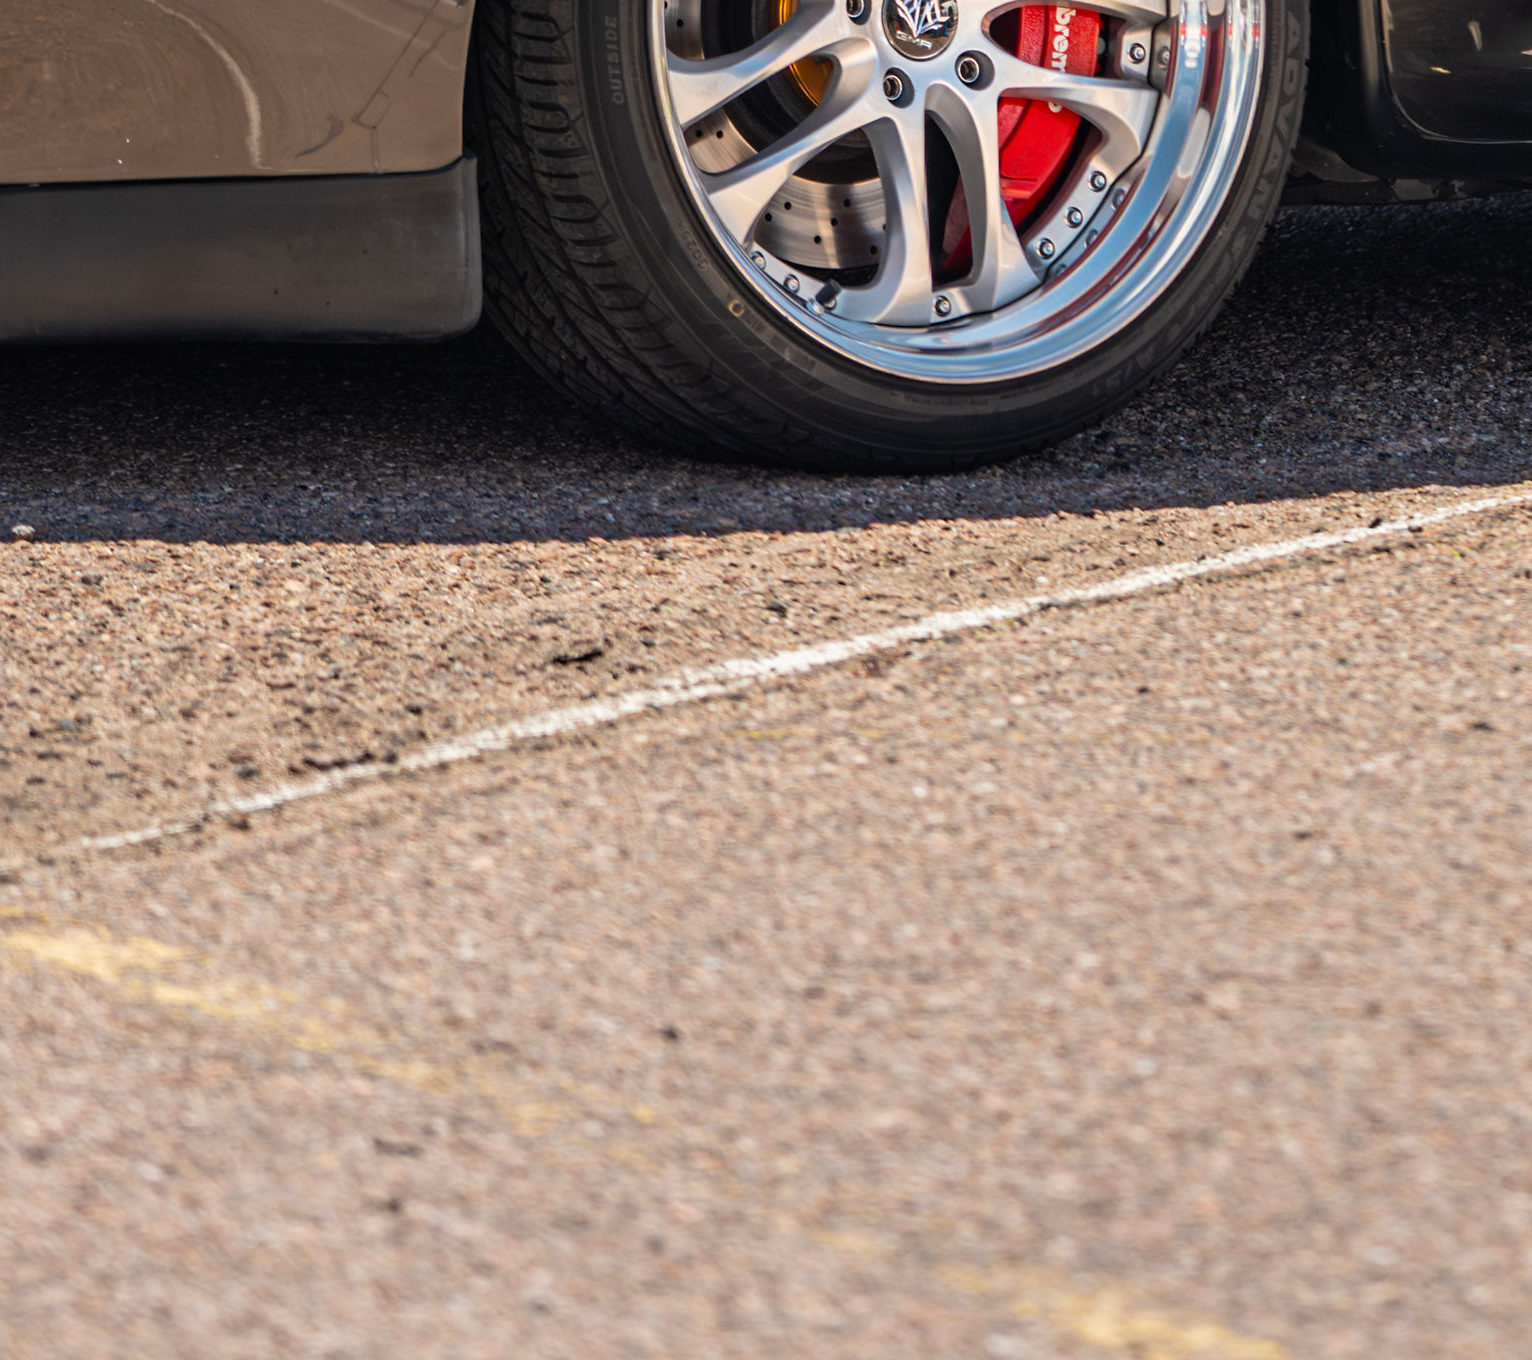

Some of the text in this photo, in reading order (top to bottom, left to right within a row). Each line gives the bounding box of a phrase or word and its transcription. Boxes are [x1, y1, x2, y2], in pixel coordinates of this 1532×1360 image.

[604, 15, 626, 105] OUTSIDE
[1047, 7, 1076, 113] bremo
[1245, 11, 1302, 218] ADVAN
